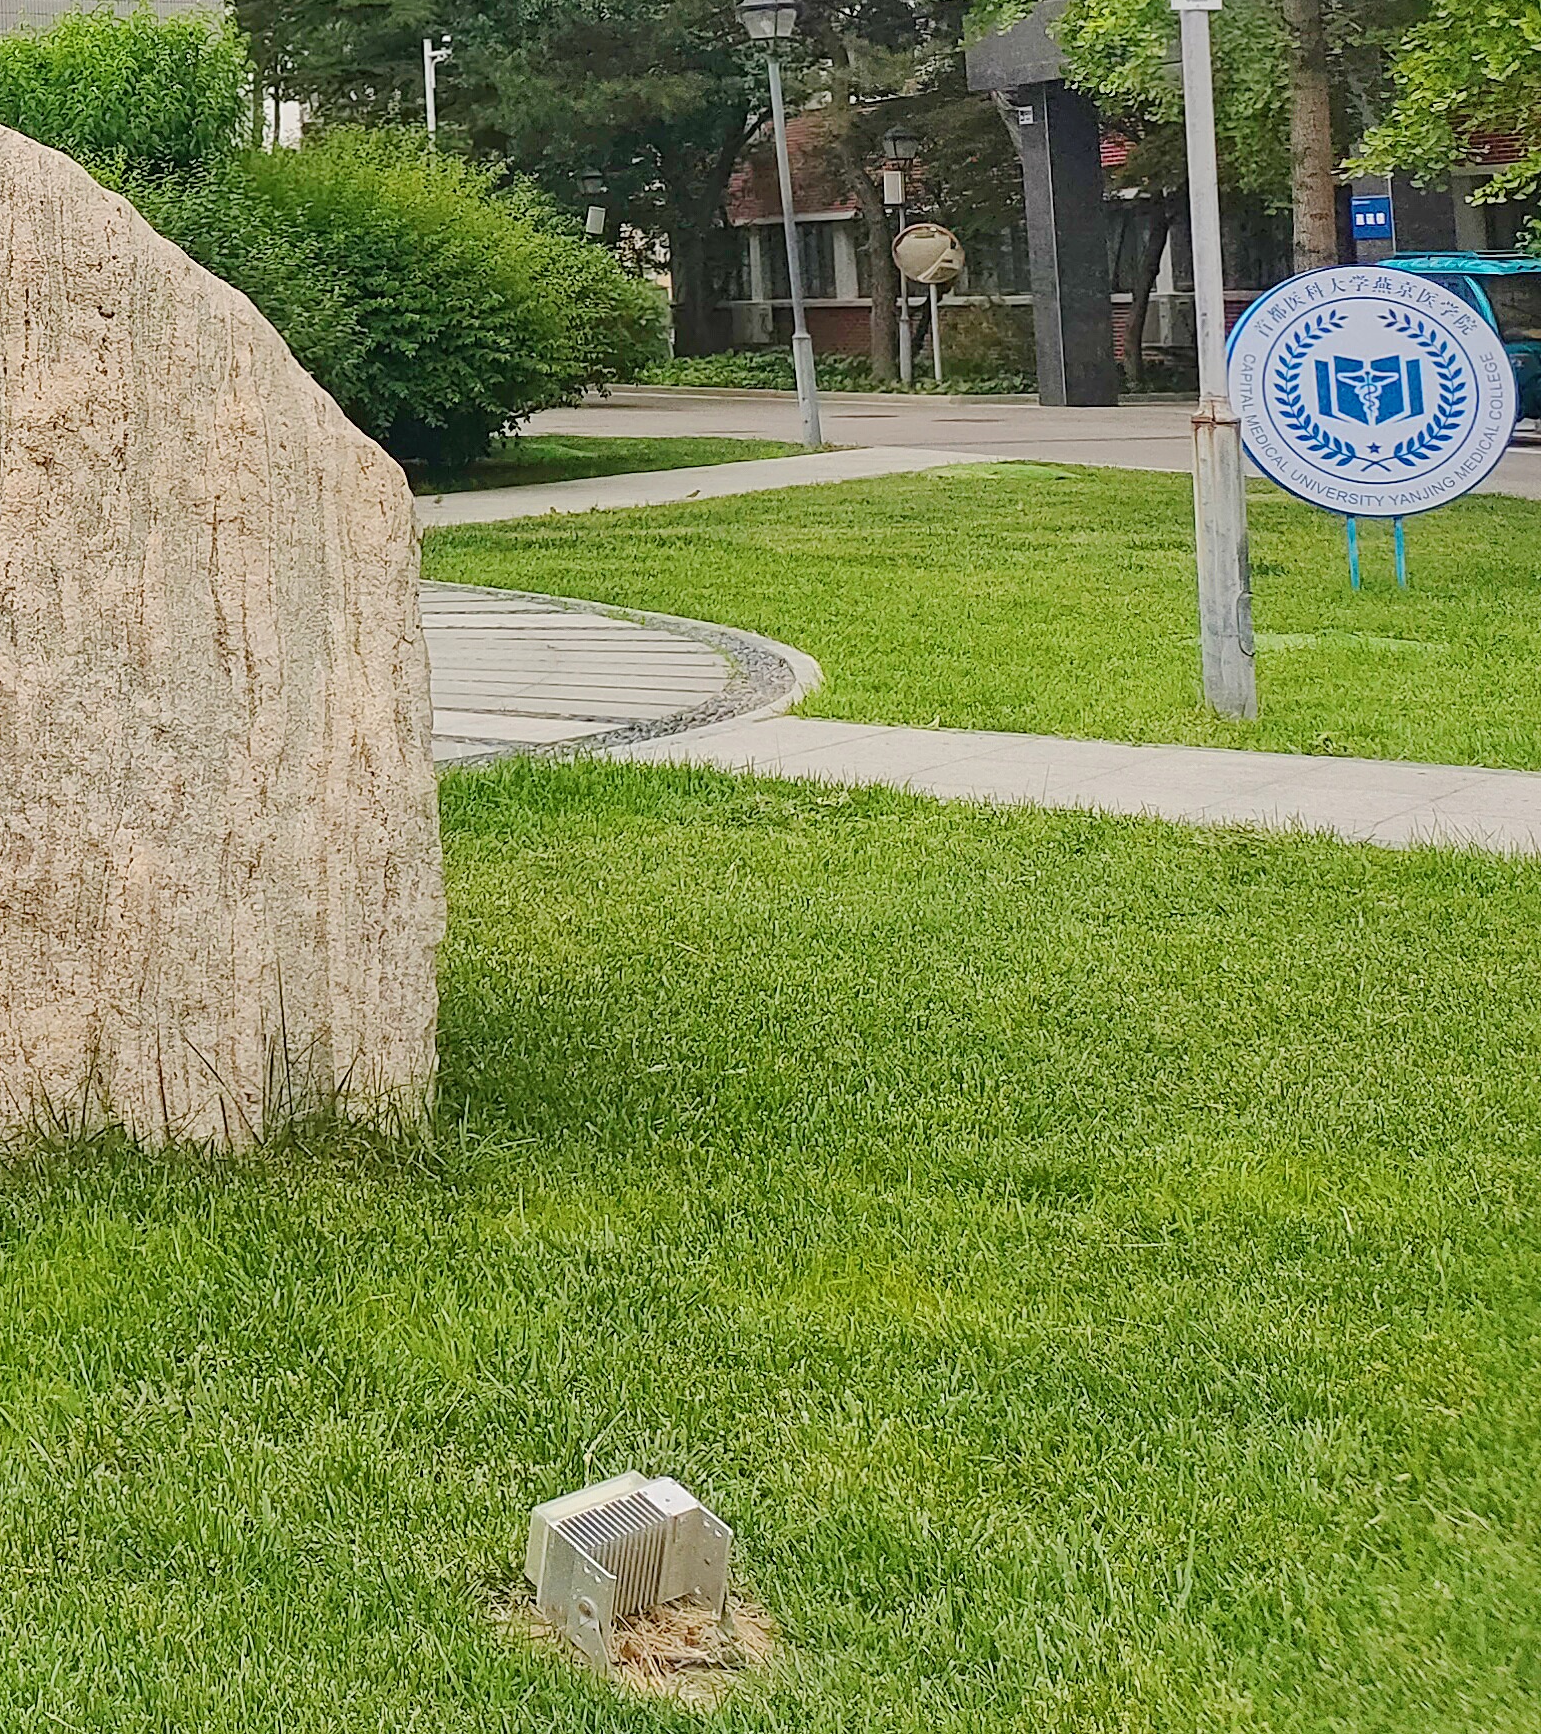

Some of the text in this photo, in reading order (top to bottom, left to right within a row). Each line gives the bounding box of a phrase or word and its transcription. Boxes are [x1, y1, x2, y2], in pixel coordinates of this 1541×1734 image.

[1254, 274, 1478, 337] 首都医科大学燕京医学院
[1239, 352, 1504, 507] CAPITAL MEDICAL UNIVERSITY YANJING MEDICAL COLLEGE
